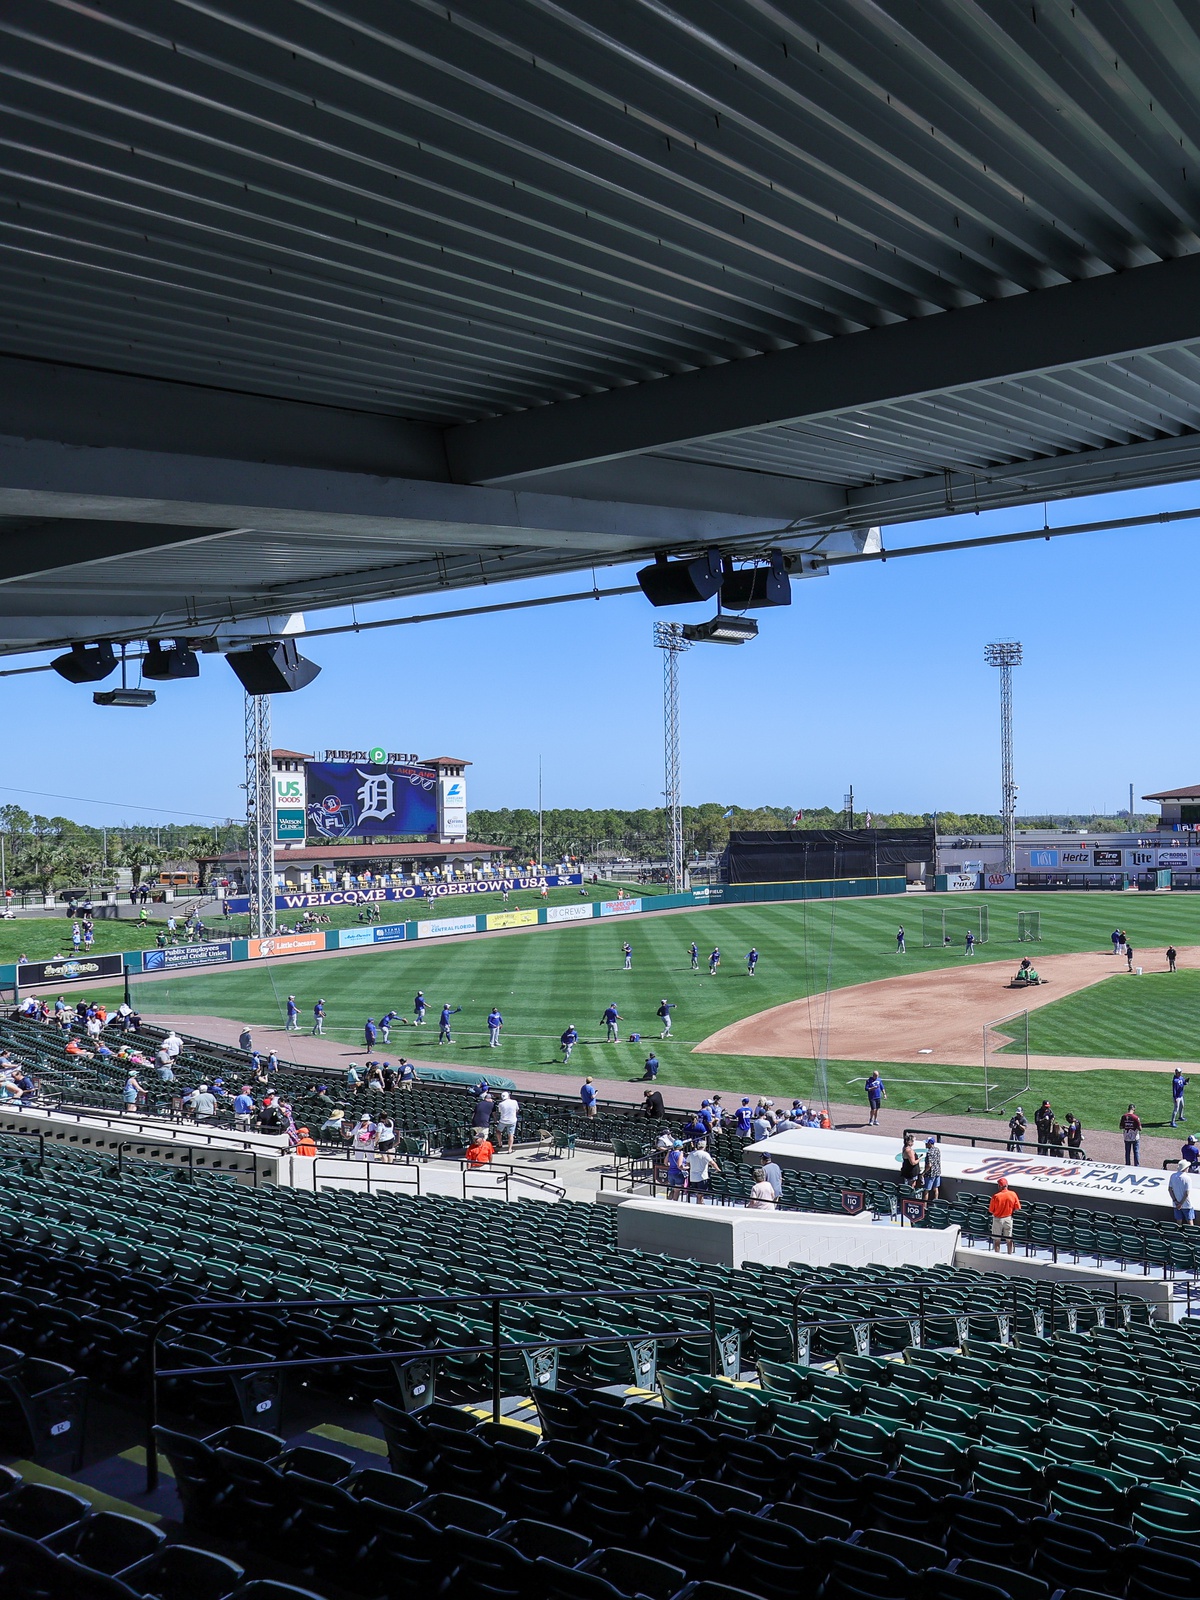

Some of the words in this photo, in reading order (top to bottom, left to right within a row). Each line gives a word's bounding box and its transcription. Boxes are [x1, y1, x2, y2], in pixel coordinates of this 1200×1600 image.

[325, 750, 367, 760] PUBLIX
[388, 752, 419, 762] FIELD
[325, 817, 344, 829] FL
[1062, 853, 1089, 862] Hertz
[1131, 852, 1152, 866] Lite
[284, 888, 386, 908] WELCOME
[392, 887, 415, 899] TO
[519, 877, 548, 889] USA
[558, 906, 587, 917] CREWS
[454, 923, 476, 931] FLORIDA
[164, 949, 186, 957] Publix
[186, 945, 220, 955] Employees
[164, 953, 189, 962] Federal
[189, 951, 208, 960] Credit
[208, 949, 228, 957] Union
[742, 1110, 752, 1119] 12
[1062, 1159, 1125, 1171] WELCOME
[961, 1156, 1081, 1182] Tigers
[1082, 1169, 1166, 1189] FANS
[1032, 1175, 1049, 1183] TO
[1050, 1178, 1125, 1194] LAKELAND,
[1131, 1188, 1146, 1196] FL
[907, 1207, 920, 1215] 109
[260, 1402, 268, 1411] Q
[56, 1423, 65, 1433] R
